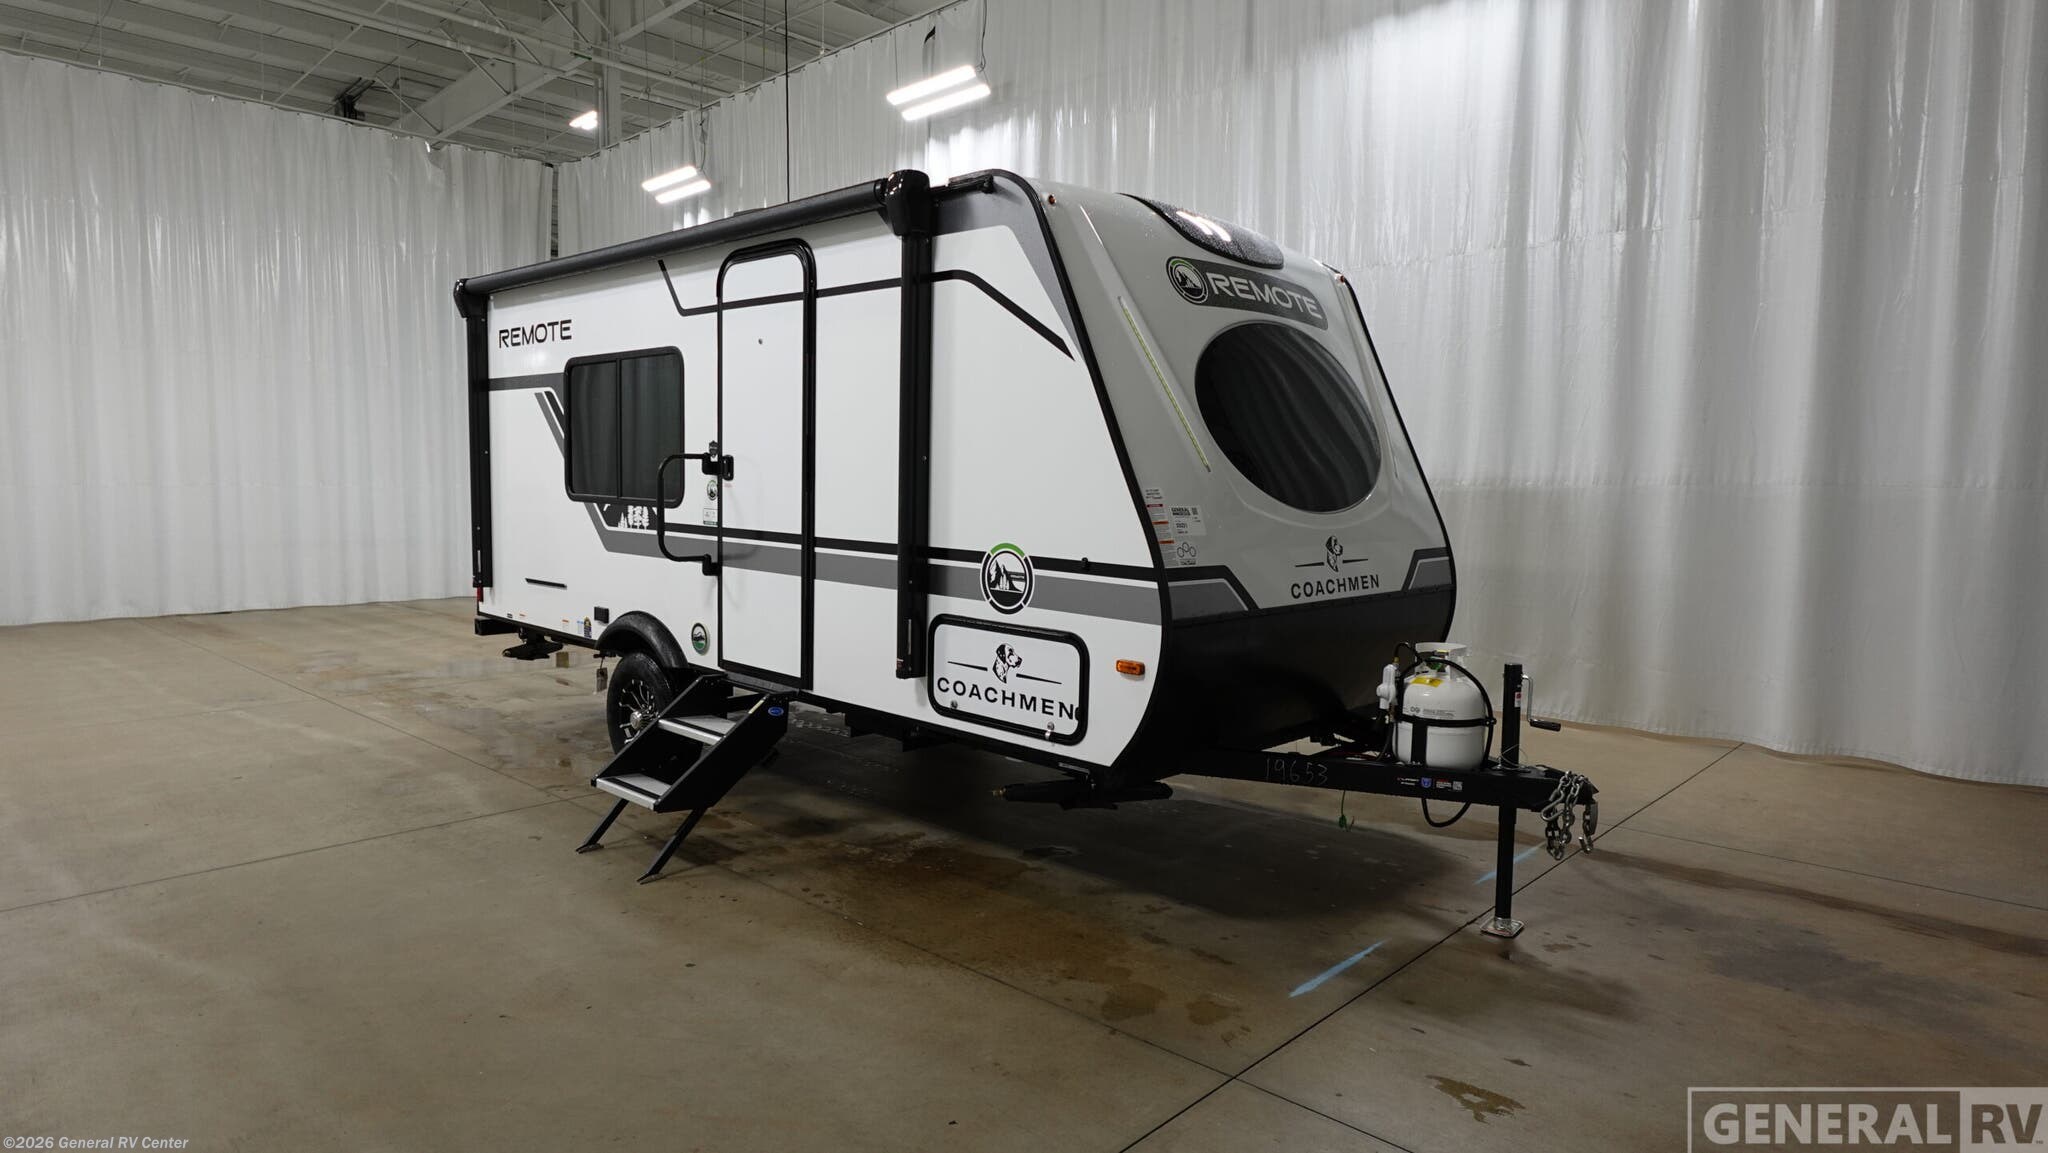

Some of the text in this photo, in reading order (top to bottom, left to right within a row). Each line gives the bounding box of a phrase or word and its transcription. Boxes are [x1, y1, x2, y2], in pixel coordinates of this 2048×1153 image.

[1206, 272, 1323, 319] REMOTE
[499, 319, 572, 349] REMOTE
[1290, 574, 1380, 599] COACHMEN
[937, 677, 1074, 720] COACHMEN
[1265, 757, 1329, 785] 19653
